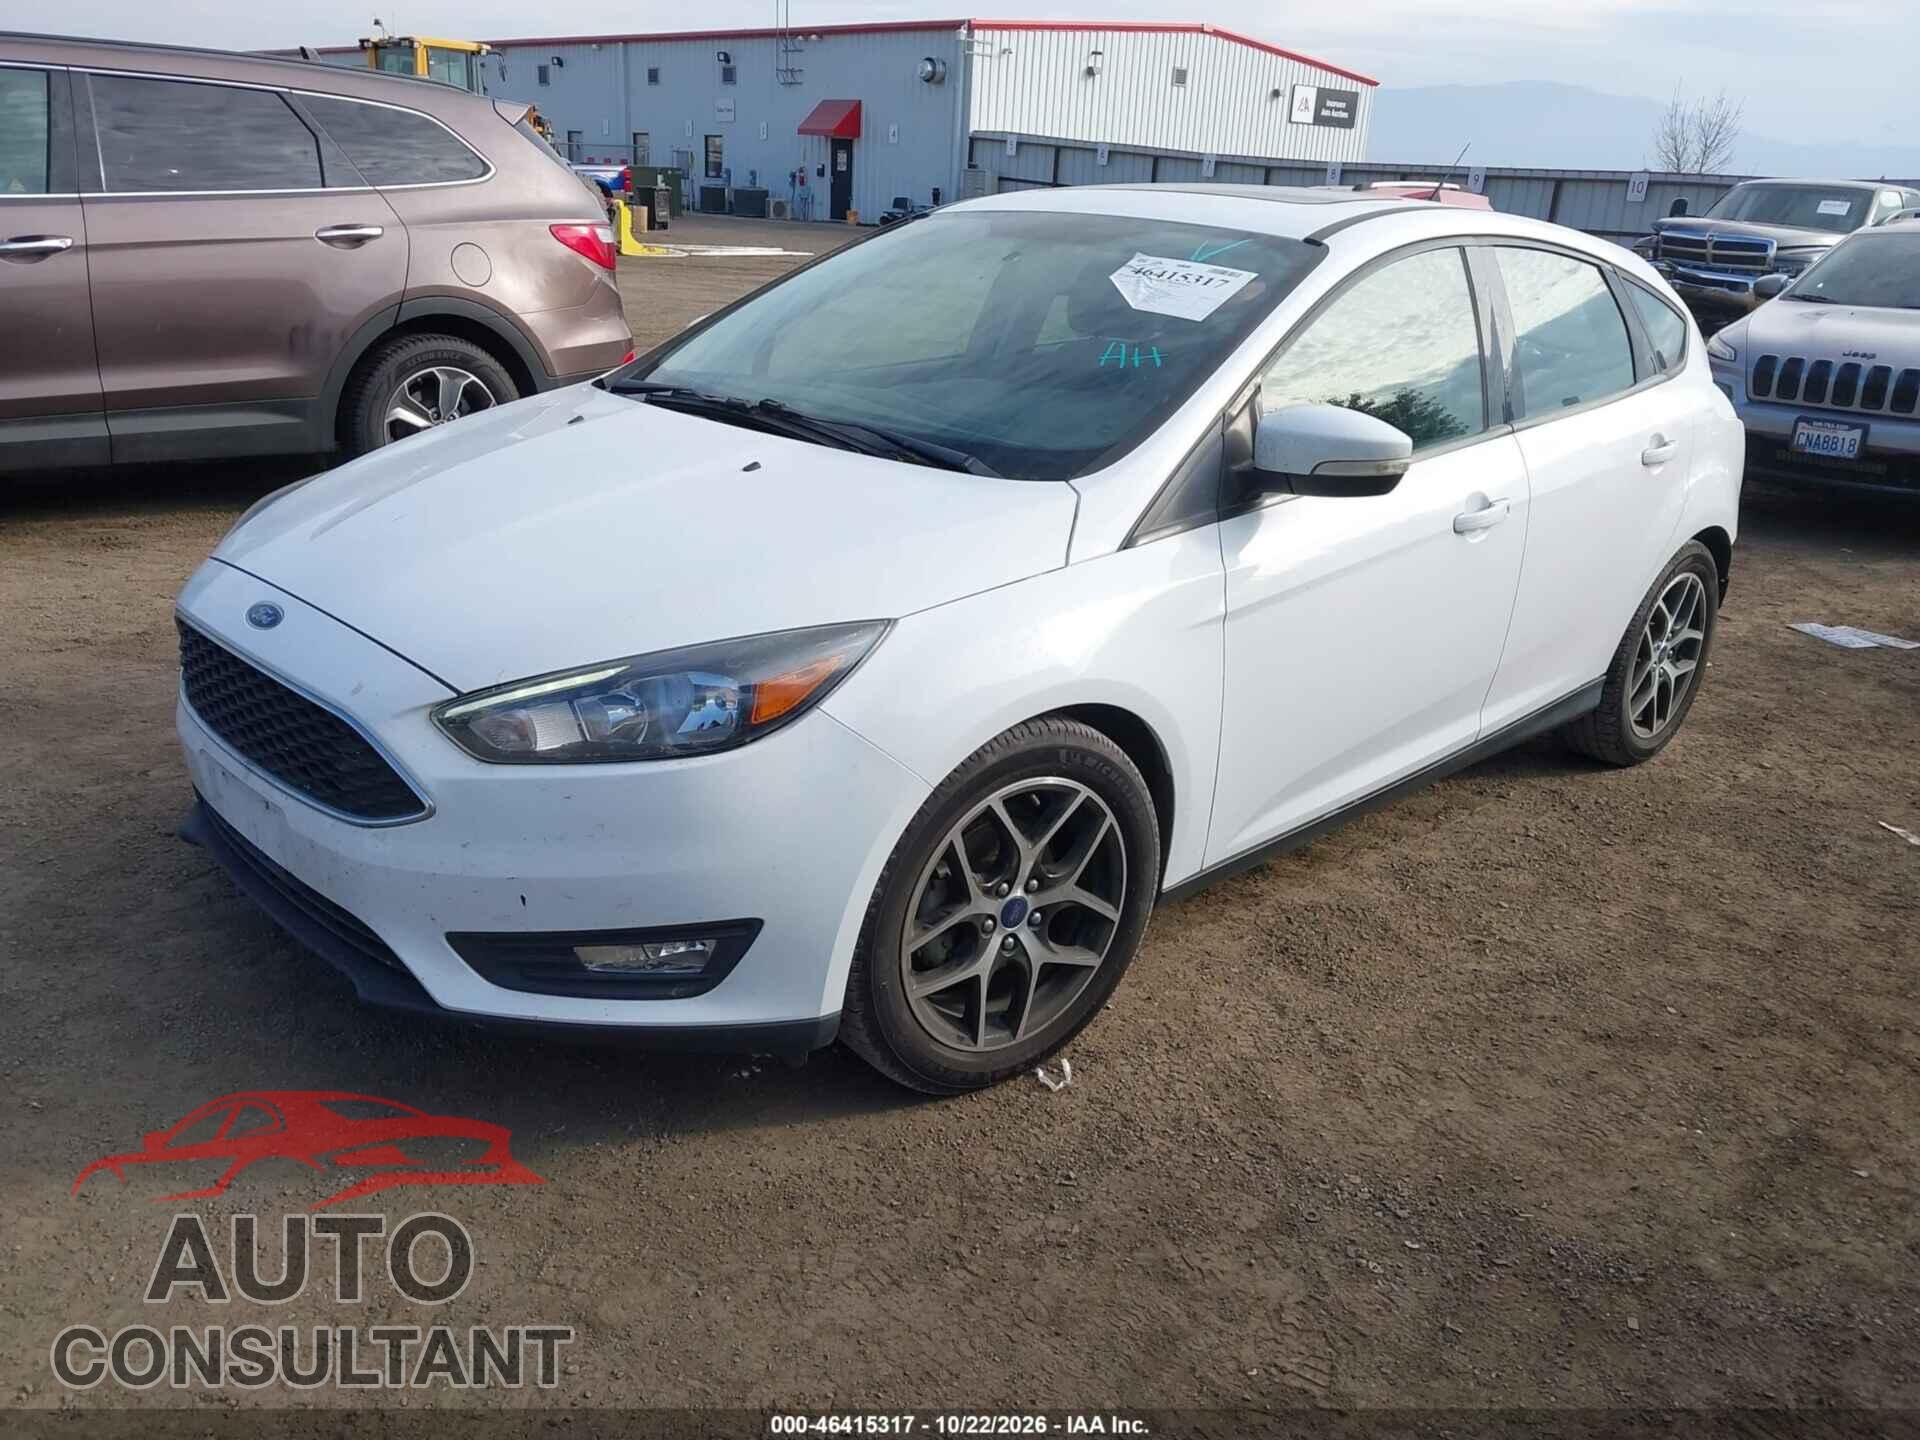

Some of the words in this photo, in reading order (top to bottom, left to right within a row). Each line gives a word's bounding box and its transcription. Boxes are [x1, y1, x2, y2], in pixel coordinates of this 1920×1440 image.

[1473, 174, 1480, 185] 9
[1631, 181, 1645, 194] 10
[1131, 266, 1231, 289] 46415317
[1842, 350, 1876, 361] Jeep
